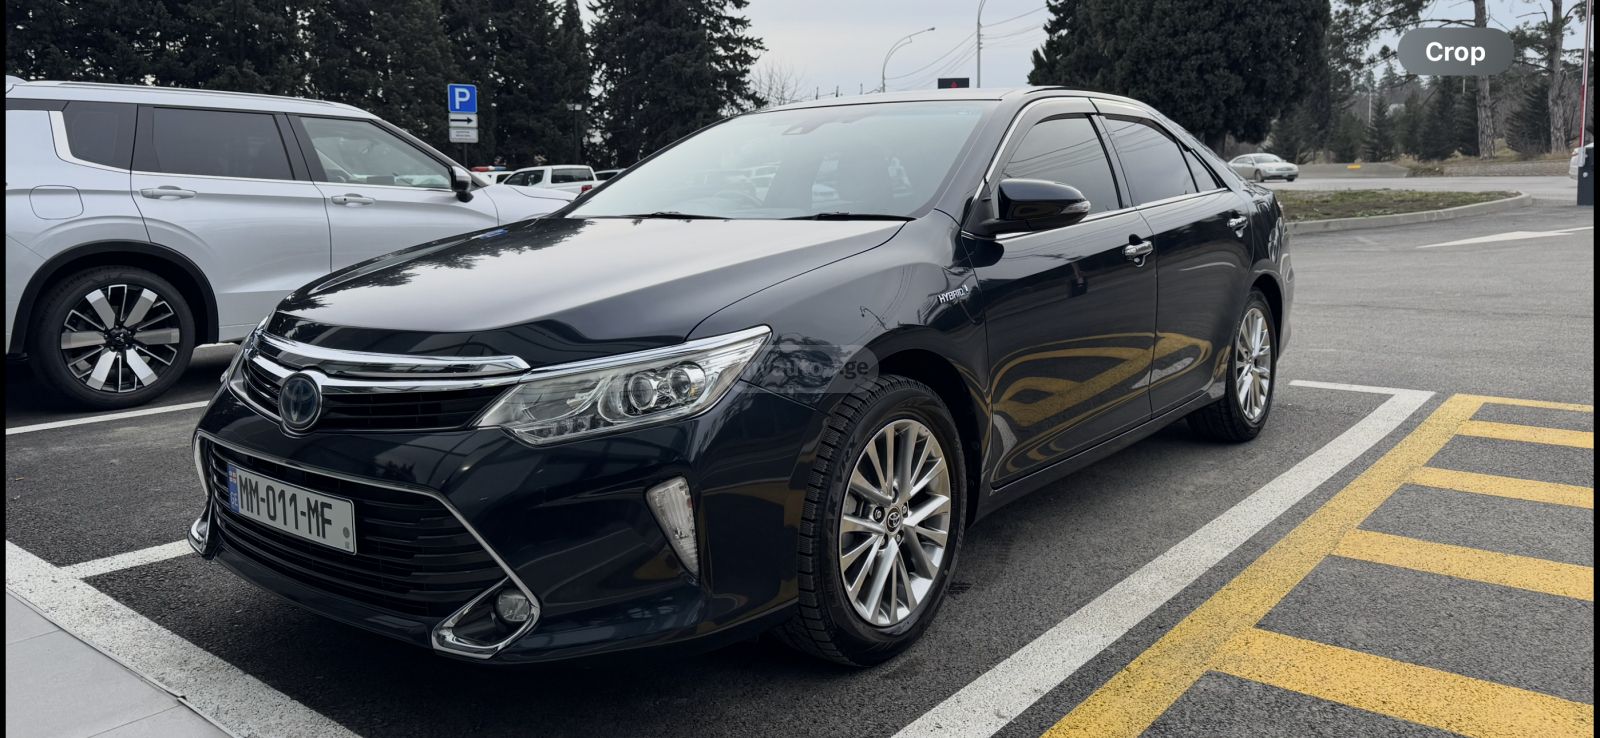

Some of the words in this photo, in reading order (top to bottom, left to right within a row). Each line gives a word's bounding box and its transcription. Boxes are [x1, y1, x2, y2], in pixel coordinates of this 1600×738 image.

[454, 87, 471, 110] P
[938, 287, 965, 304] HYBRID
[238, 475, 333, 539] MM-011-MF
